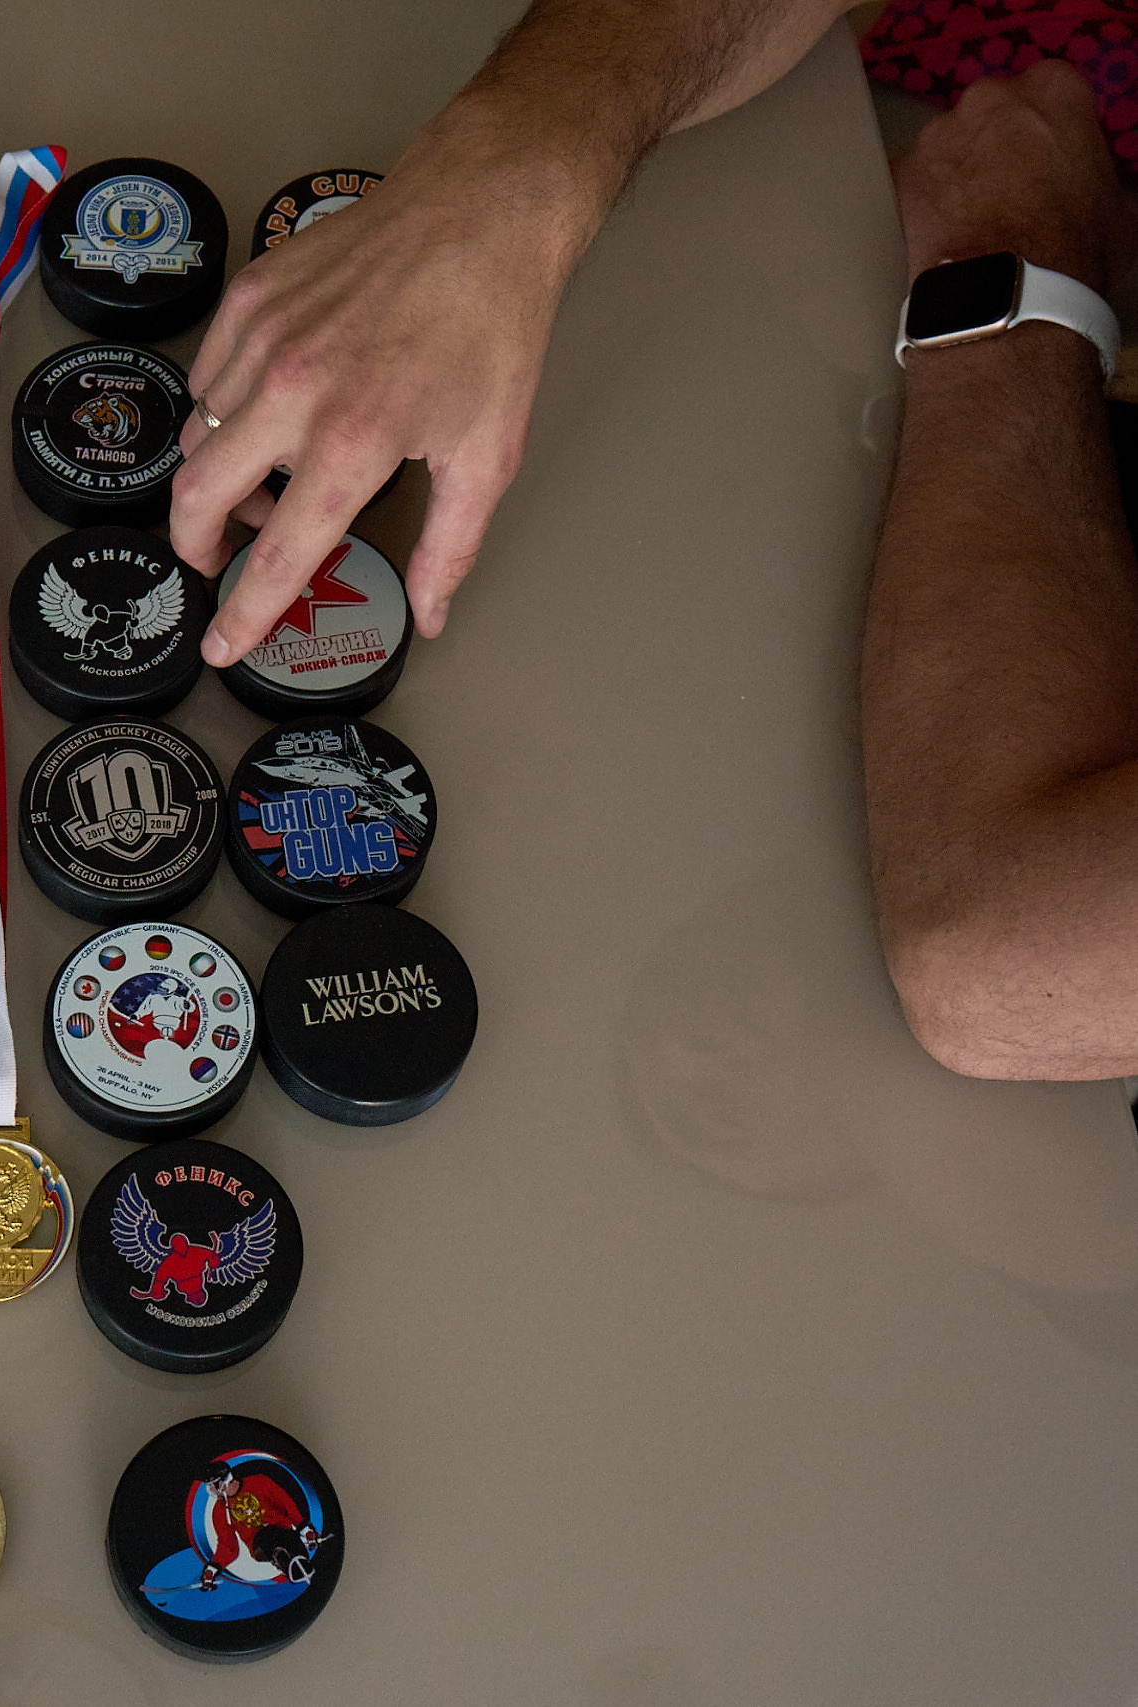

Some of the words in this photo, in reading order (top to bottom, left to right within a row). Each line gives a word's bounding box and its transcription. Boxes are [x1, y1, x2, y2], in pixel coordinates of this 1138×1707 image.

[85, 253, 108, 263] 2014
[155, 257, 178, 267] 2015
[43, 350, 134, 386] ХОККЕЙНЫЙ
[138, 356, 183, 396] ТУРНИР
[79, 373, 146, 391] Стрела
[30, 429, 78, 479] ПАМЯТИ
[76, 473, 95, 487] Д.
[119, 444, 182, 488] УШАКОВА
[75, 446, 136, 465] ТАТАНОВО
[71, 548, 162, 575] ФЕНИКС
[79, 662, 152, 678] МОСКОВСКАЯ
[150, 631, 184, 666] ОБЛАСТЬ
[248, 627, 384, 668] УДМУРТИЯ
[41, 729, 102, 780] KONTINENTAL
[104, 725, 149, 738] HOCKEY
[150, 732, 192, 761] LEAGUE
[274, 735, 344, 757] 2018
[77, 749, 161, 822] 10
[30, 811, 51, 824] EST.
[283, 784, 358, 832] TOP
[85, 825, 108, 841] 2017
[149, 819, 173, 830] 2018
[281, 820, 400, 881] GUNS
[67, 861, 120, 888] REGULAR
[122, 845, 200, 888] CHAMPIONSHIP
[80, 941, 102, 958] CZECH
[100, 927, 133, 945] REPUBLIC
[142, 925, 181, 935] GERMANY
[206, 943, 226, 960] ITALY
[58, 966, 76, 996] CANADA
[149, 964, 169, 973] 2015
[194, 988, 210, 1019] SLEDGE
[237, 982, 252, 1006] JAPAN
[302, 986, 442, 1026] LAWSON'S
[191, 1020, 210, 1052] HOCKEY
[237, 1028, 252, 1061] NORWAY
[141, 1091, 154, 1100] NY
[144, 1083, 162, 1093] MAY
[204, 1076, 230, 1096] RUSSIA
[154, 1165, 255, 1207] ФЕНИКС
[145, 1303, 226, 1328] МОСКОВСКАЯ
[225, 1279, 268, 1319] ОБЛАСТЬ
